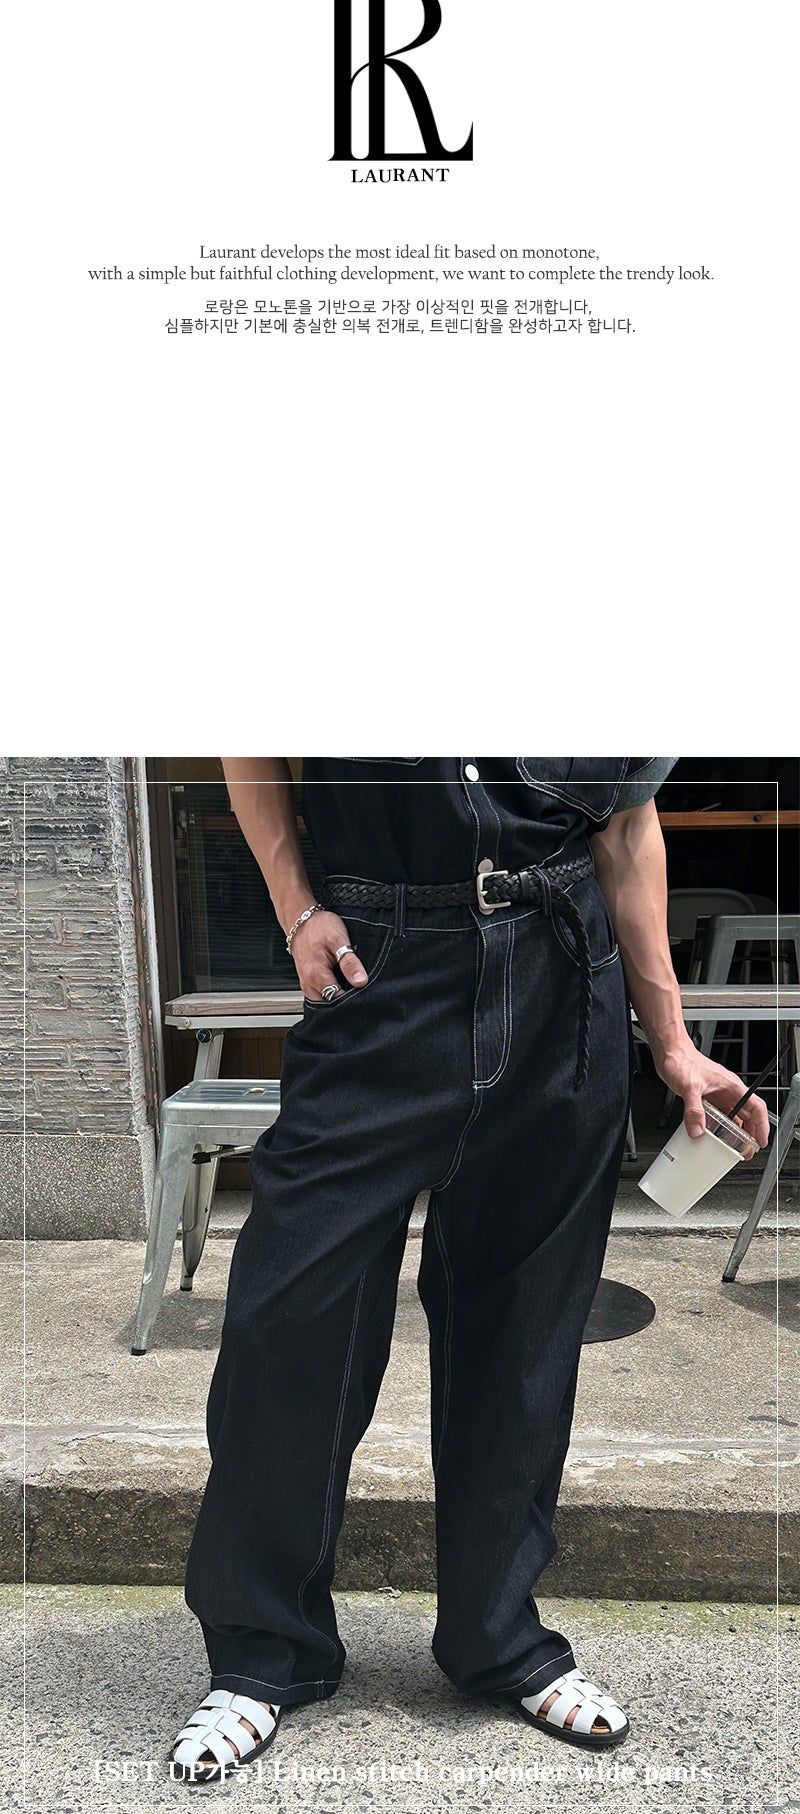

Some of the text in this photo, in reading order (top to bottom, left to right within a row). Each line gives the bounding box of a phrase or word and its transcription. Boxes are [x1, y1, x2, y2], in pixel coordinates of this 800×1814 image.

[351, 168, 450, 183] LAURANT
[200, 244, 599, 263] Laurant develops the most ideal fit based on monotone,
[88, 266, 713, 284] with a simple but faithful clothing development, we want to complete the trendy look.
[204, 299, 591, 315] 로랑은 모노톤을 기반으로 가장 이상적인 핏을 전개합니다,
